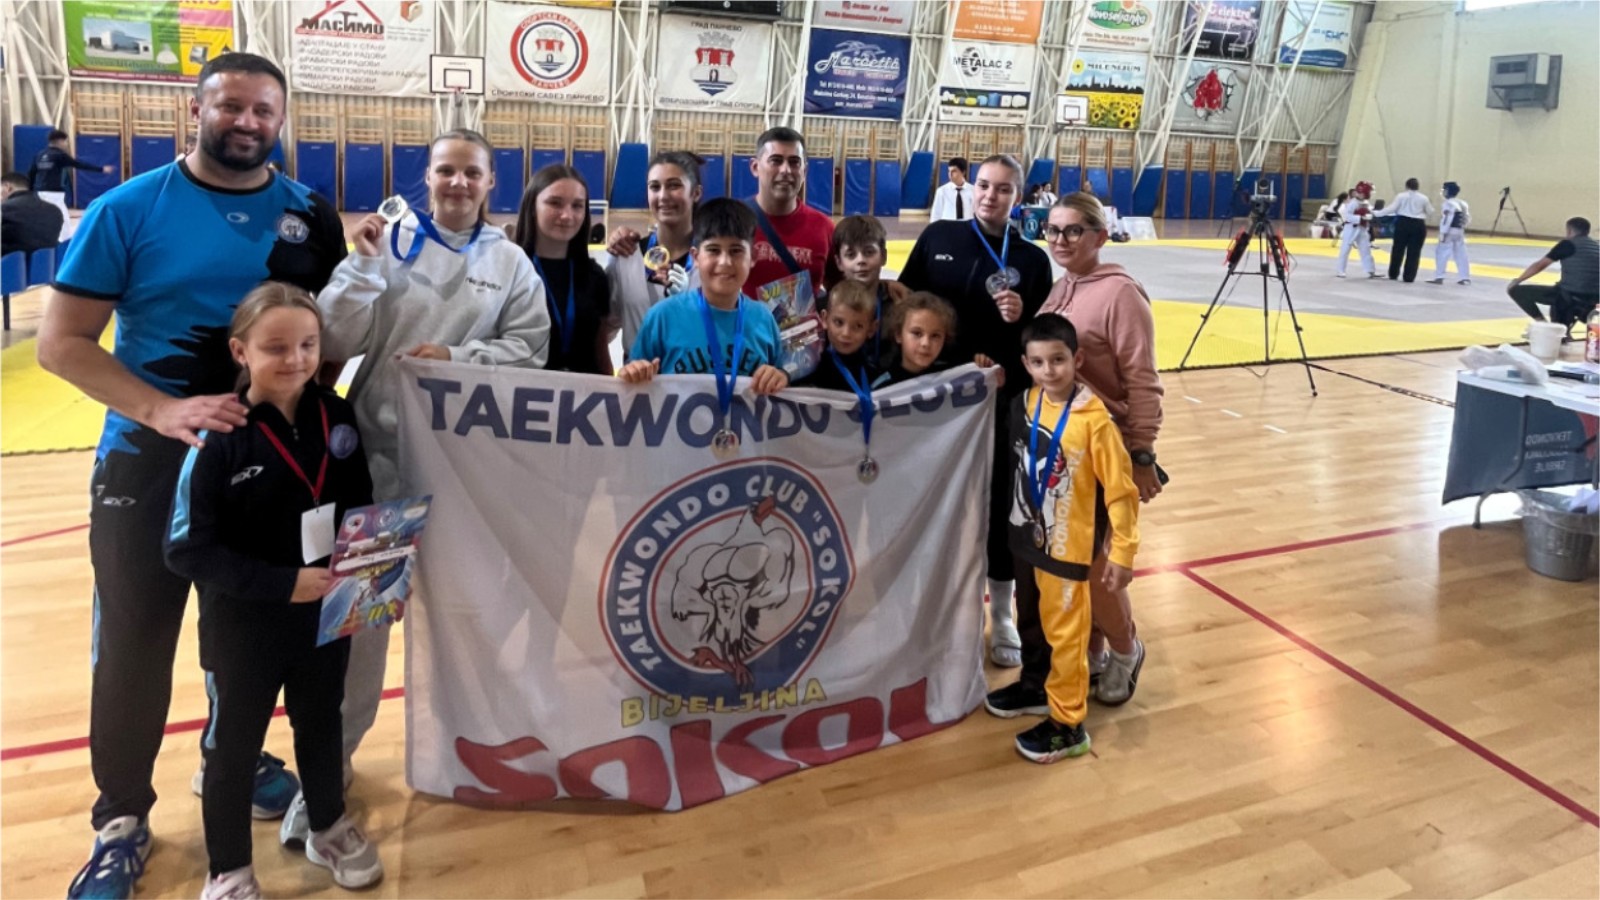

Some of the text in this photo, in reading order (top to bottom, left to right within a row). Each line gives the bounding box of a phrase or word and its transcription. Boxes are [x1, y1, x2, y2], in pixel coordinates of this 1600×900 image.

[491, 89, 605, 102] СПОРТСКИ САВЕЗ ПАНЧЕВО
[954, 56, 1013, 70] METALAC 2
[417, 377, 830, 449] TAEKWONDO
[1052, 447, 1086, 557] TAWONDO
[616, 483, 730, 671] TAEKWONDO
[745, 475, 809, 514] CLUB
[620, 677, 826, 729] BIJELJINA
[453, 676, 960, 812] SOKOL
